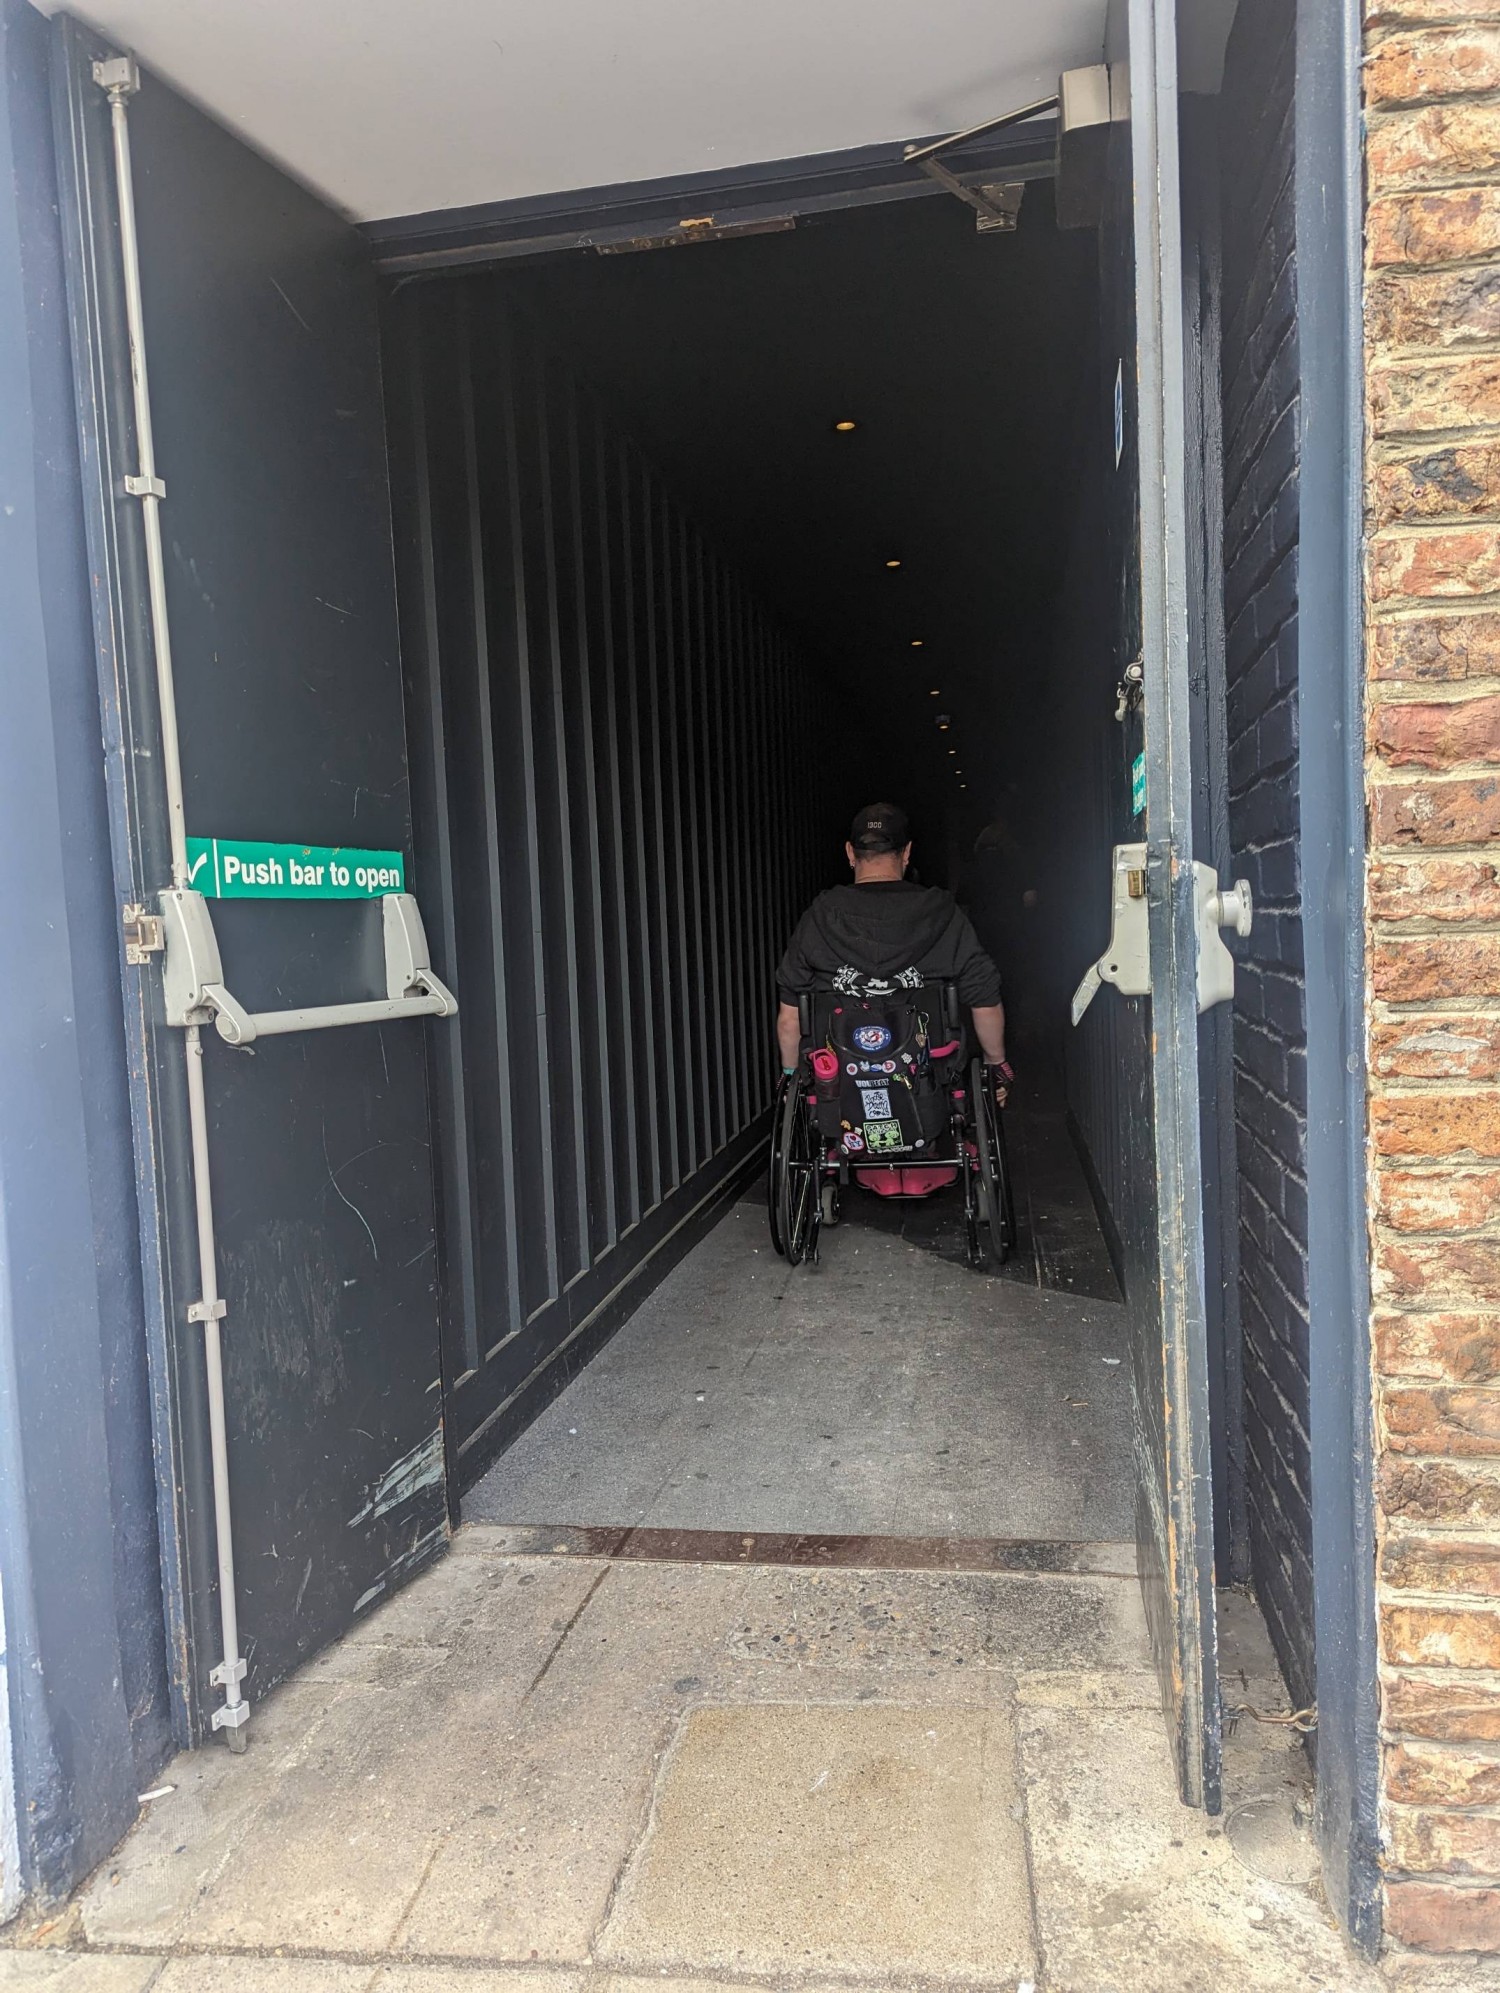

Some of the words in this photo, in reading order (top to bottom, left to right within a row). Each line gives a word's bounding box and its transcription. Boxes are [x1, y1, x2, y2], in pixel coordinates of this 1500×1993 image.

[223, 855, 283, 886] Push
[289, 858, 325, 887] bar
[329, 861, 350, 887] to
[355, 867, 401, 893] open
